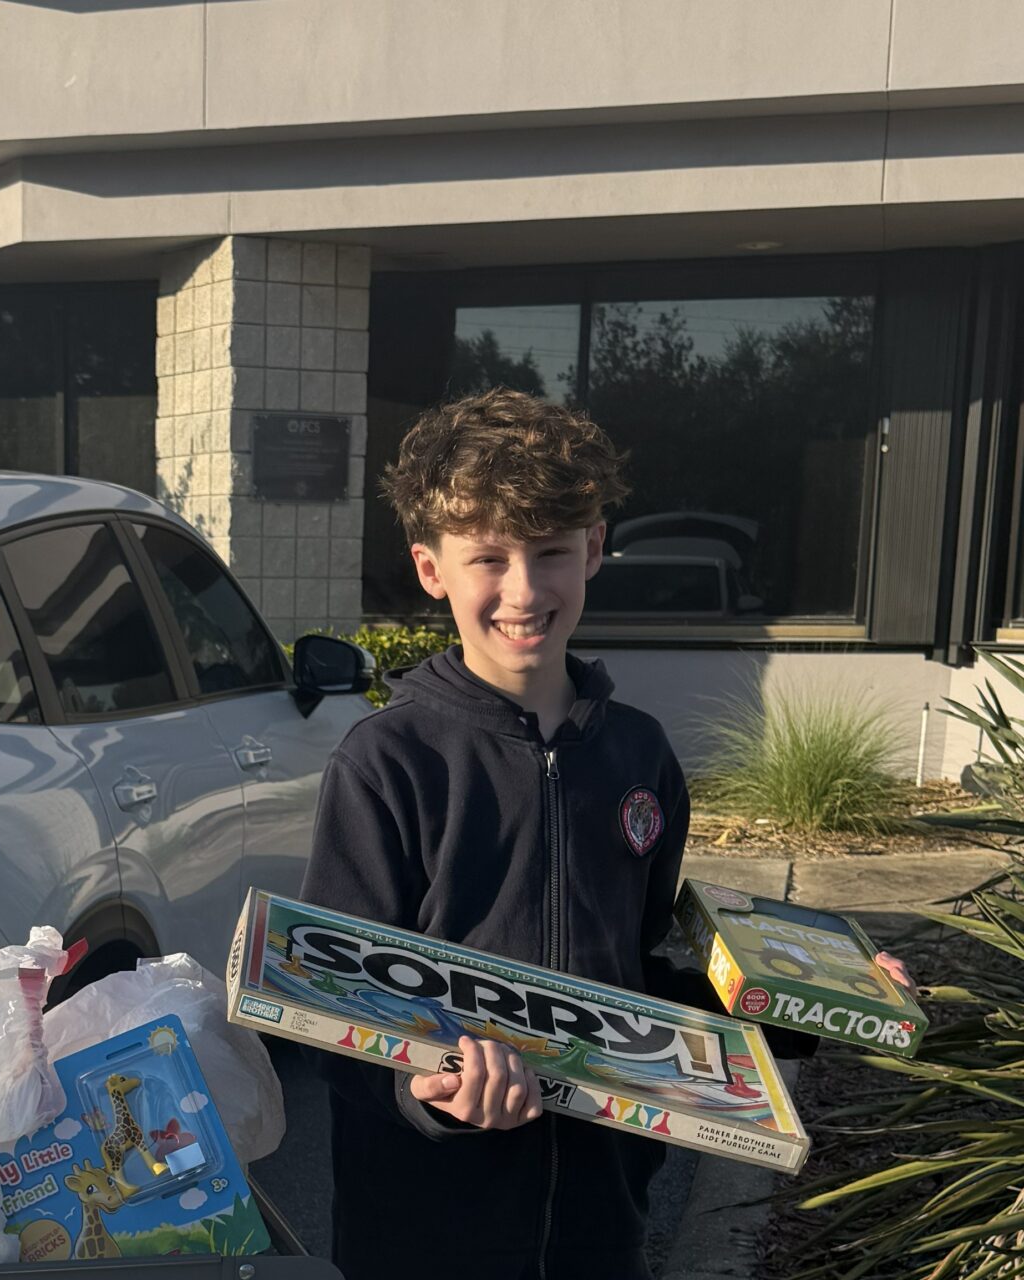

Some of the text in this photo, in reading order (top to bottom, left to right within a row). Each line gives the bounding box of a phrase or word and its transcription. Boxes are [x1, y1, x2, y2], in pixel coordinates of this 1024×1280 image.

[771, 992, 912, 1049] TRACTORS
[696, 1132, 781, 1159] SLIDE PURSUIT GAME
[699, 1125, 776, 1150] PARKER BROTHERS
[22, 1143, 72, 1173] Little
[2, 1176, 57, 1215] Friend
[27, 1234, 66, 1263] BRICKS
